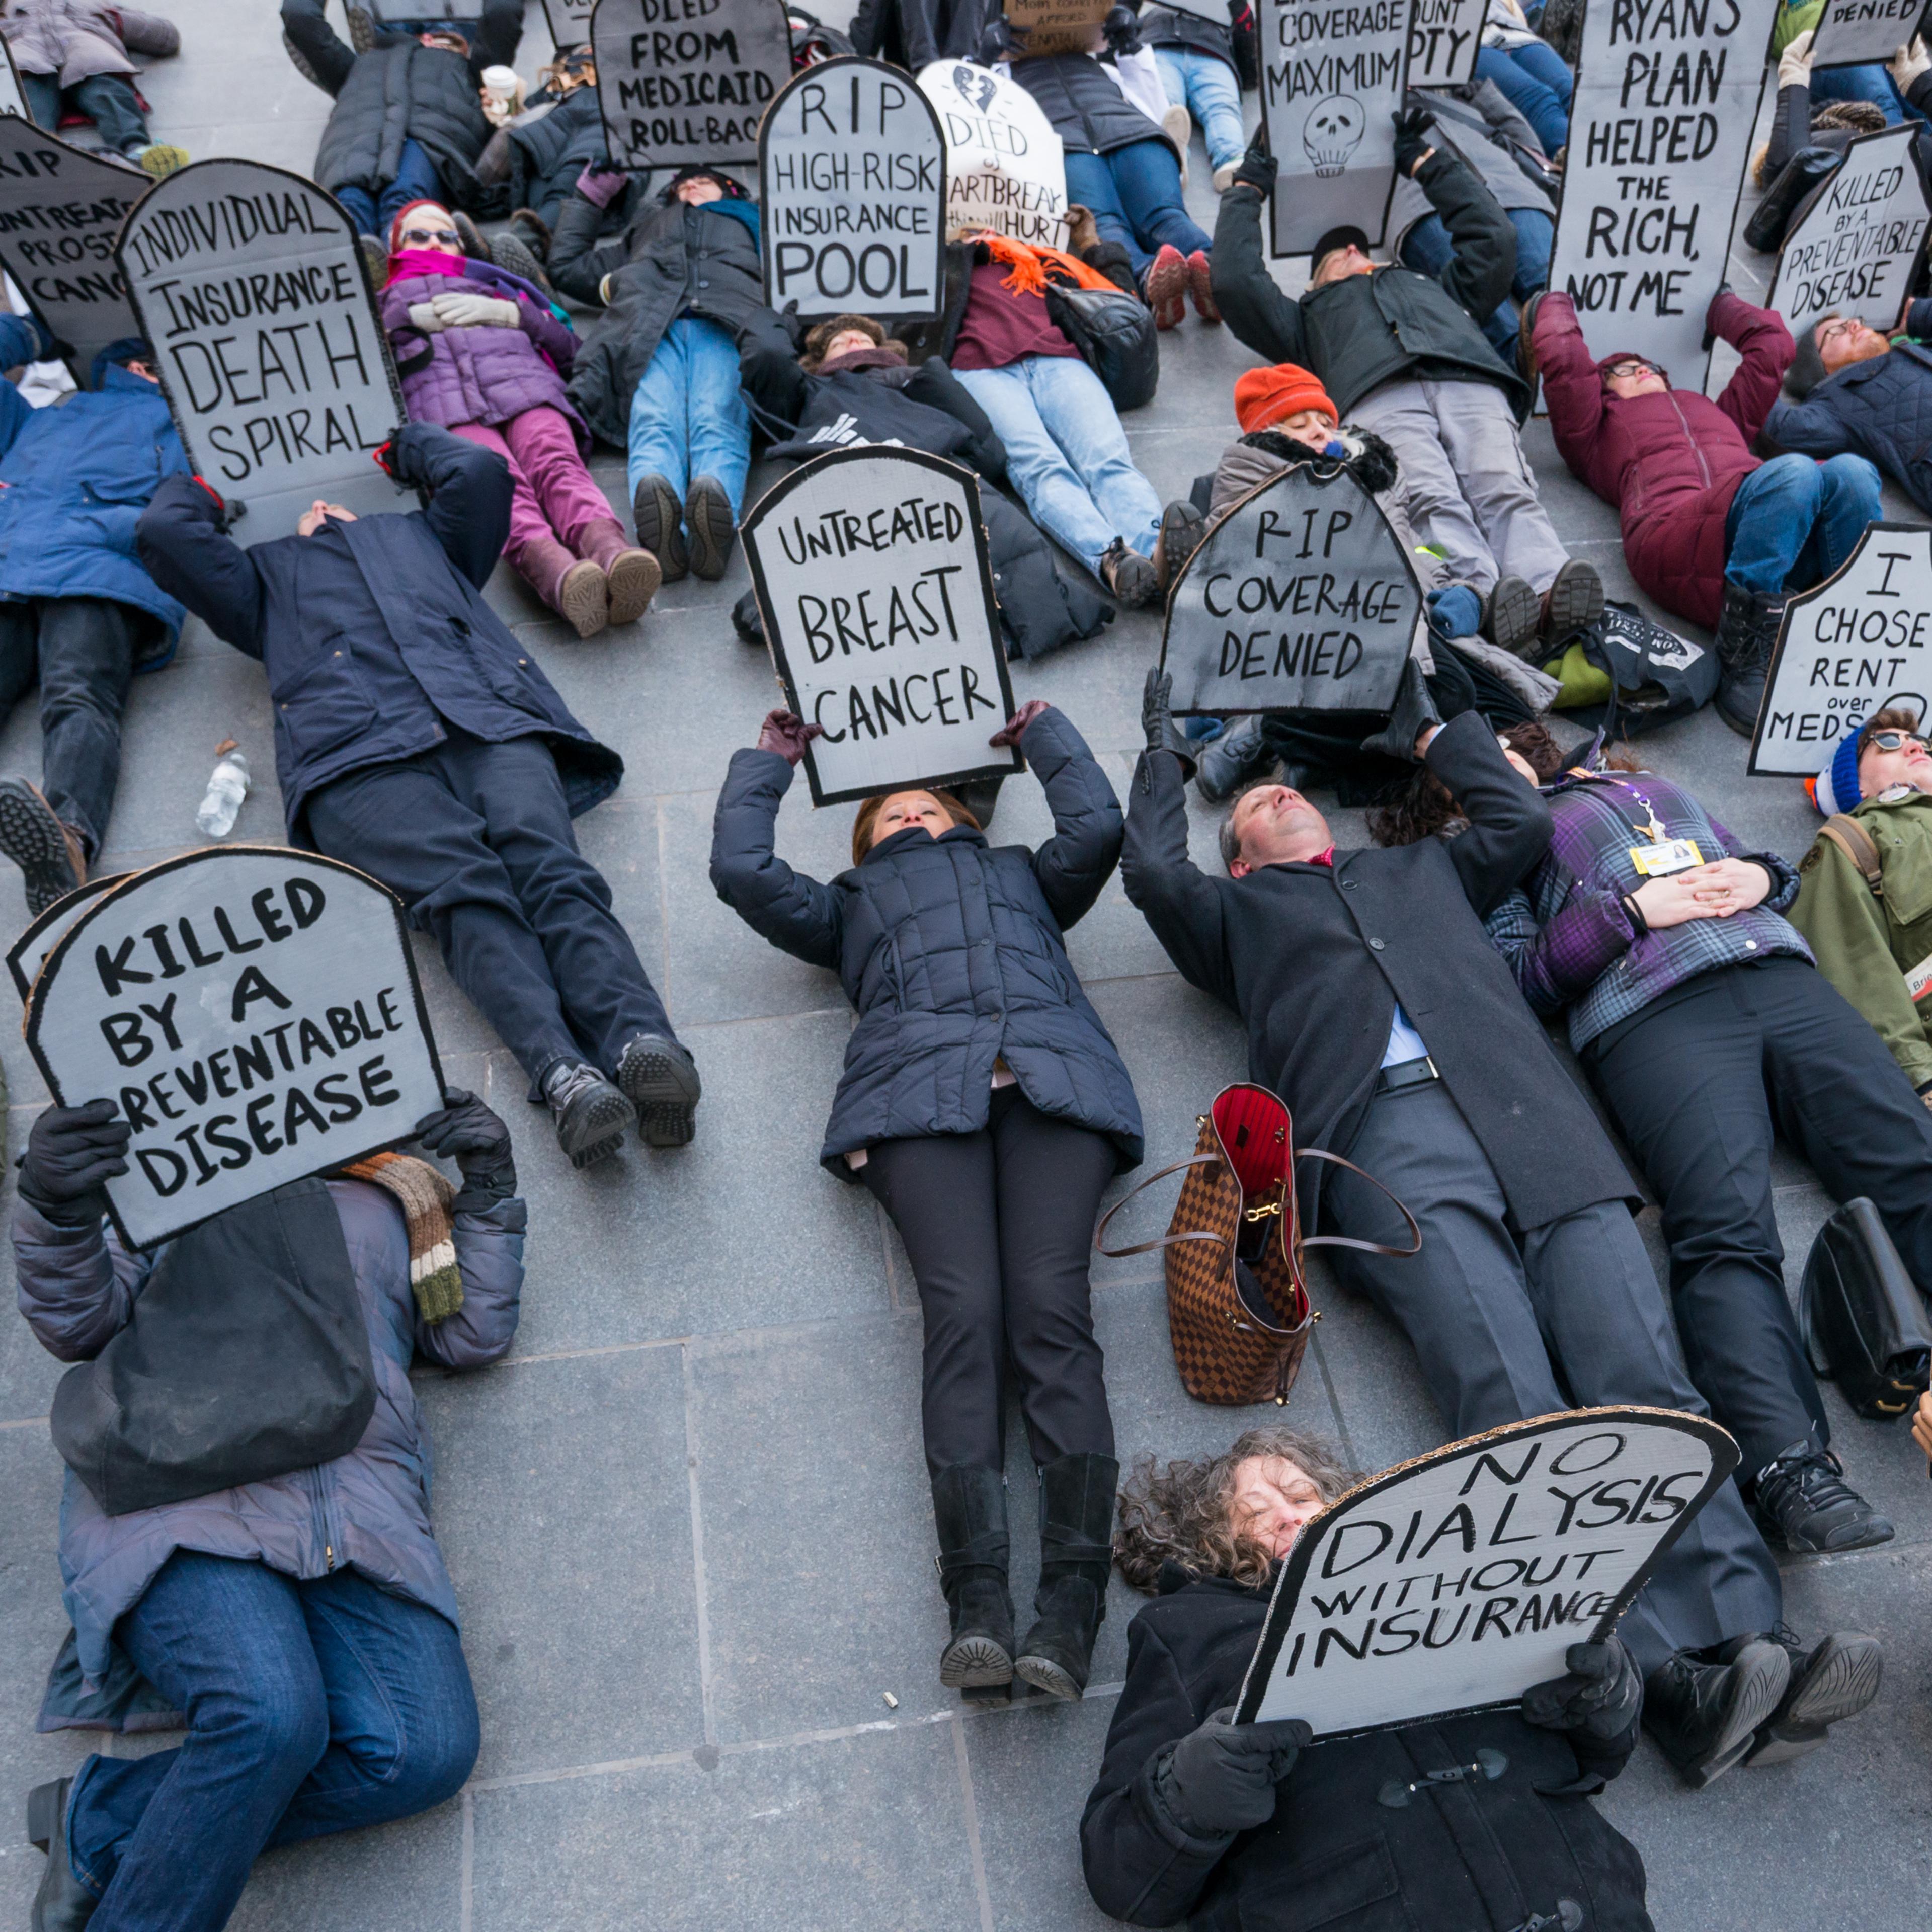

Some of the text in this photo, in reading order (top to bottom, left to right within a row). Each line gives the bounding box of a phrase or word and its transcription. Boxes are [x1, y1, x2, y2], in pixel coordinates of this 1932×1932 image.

[641, 0, 719, 23] DIED
[1279, 1, 1405, 47] COVERAGE
[1833, 0, 1916, 24] DENIED
[631, 29, 740, 68] FROM
[619, 71, 775, 110] MEDICAID
[1267, 48, 1401, 107] MAXIMUM
[1620, 48, 1727, 108] PLAN
[801, 76, 905, 136] RIP
[946, 113, 1027, 156] DIED
[983, 153, 1000, 171] of
[1586, 112, 1718, 167] HELPED
[774, 153, 936, 192] HIGH-RISK
[946, 174, 1064, 215] ARTBREAK
[1617, 175, 1670, 201] THE
[1826, 166, 1903, 215] KILLED
[129, 192, 340, 277] INDIVIDUAL
[775, 204, 931, 235] INSURANCE
[1005, 210, 1065, 246] HURT
[1586, 204, 1700, 261] RICH,
[1834, 208, 1868, 233] BY A
[775, 242, 929, 299] POOL
[1786, 220, 1926, 282] PREVENTABLE
[149, 263, 356, 338] INSURANCE
[1566, 270, 1692, 316] NOT ME
[1791, 261, 1892, 319] DISEASE
[168, 310, 370, 414] DEATH
[209, 404, 389, 481] SPIRAL
[778, 498, 963, 565] UNTREATED
[1255, 508, 1352, 559] RIP
[1203, 572, 1404, 623] COVERAGE
[1867, 552, 1912, 597] I
[798, 565, 962, 664] BREAST
[1815, 607, 1931, 648] CHOSE
[1218, 630, 1363, 680] DENIED
[1810, 658, 1906, 687] RENT
[814, 664, 996, 744] CANCER
[1827, 697, 1872, 711] over
[95, 877, 327, 997] KILLED
[100, 965, 293, 1067] BY A
[120, 987, 404, 1135] REVENTABLE
[134, 1054, 400, 1197] DISEASE
[1458, 1432, 1627, 1496] NO
[1320, 1471, 1704, 1579] DIALYSIS
[1310, 1548, 1625, 1619] WITHOUT
[1286, 1590, 1618, 1678] INSURANCE
